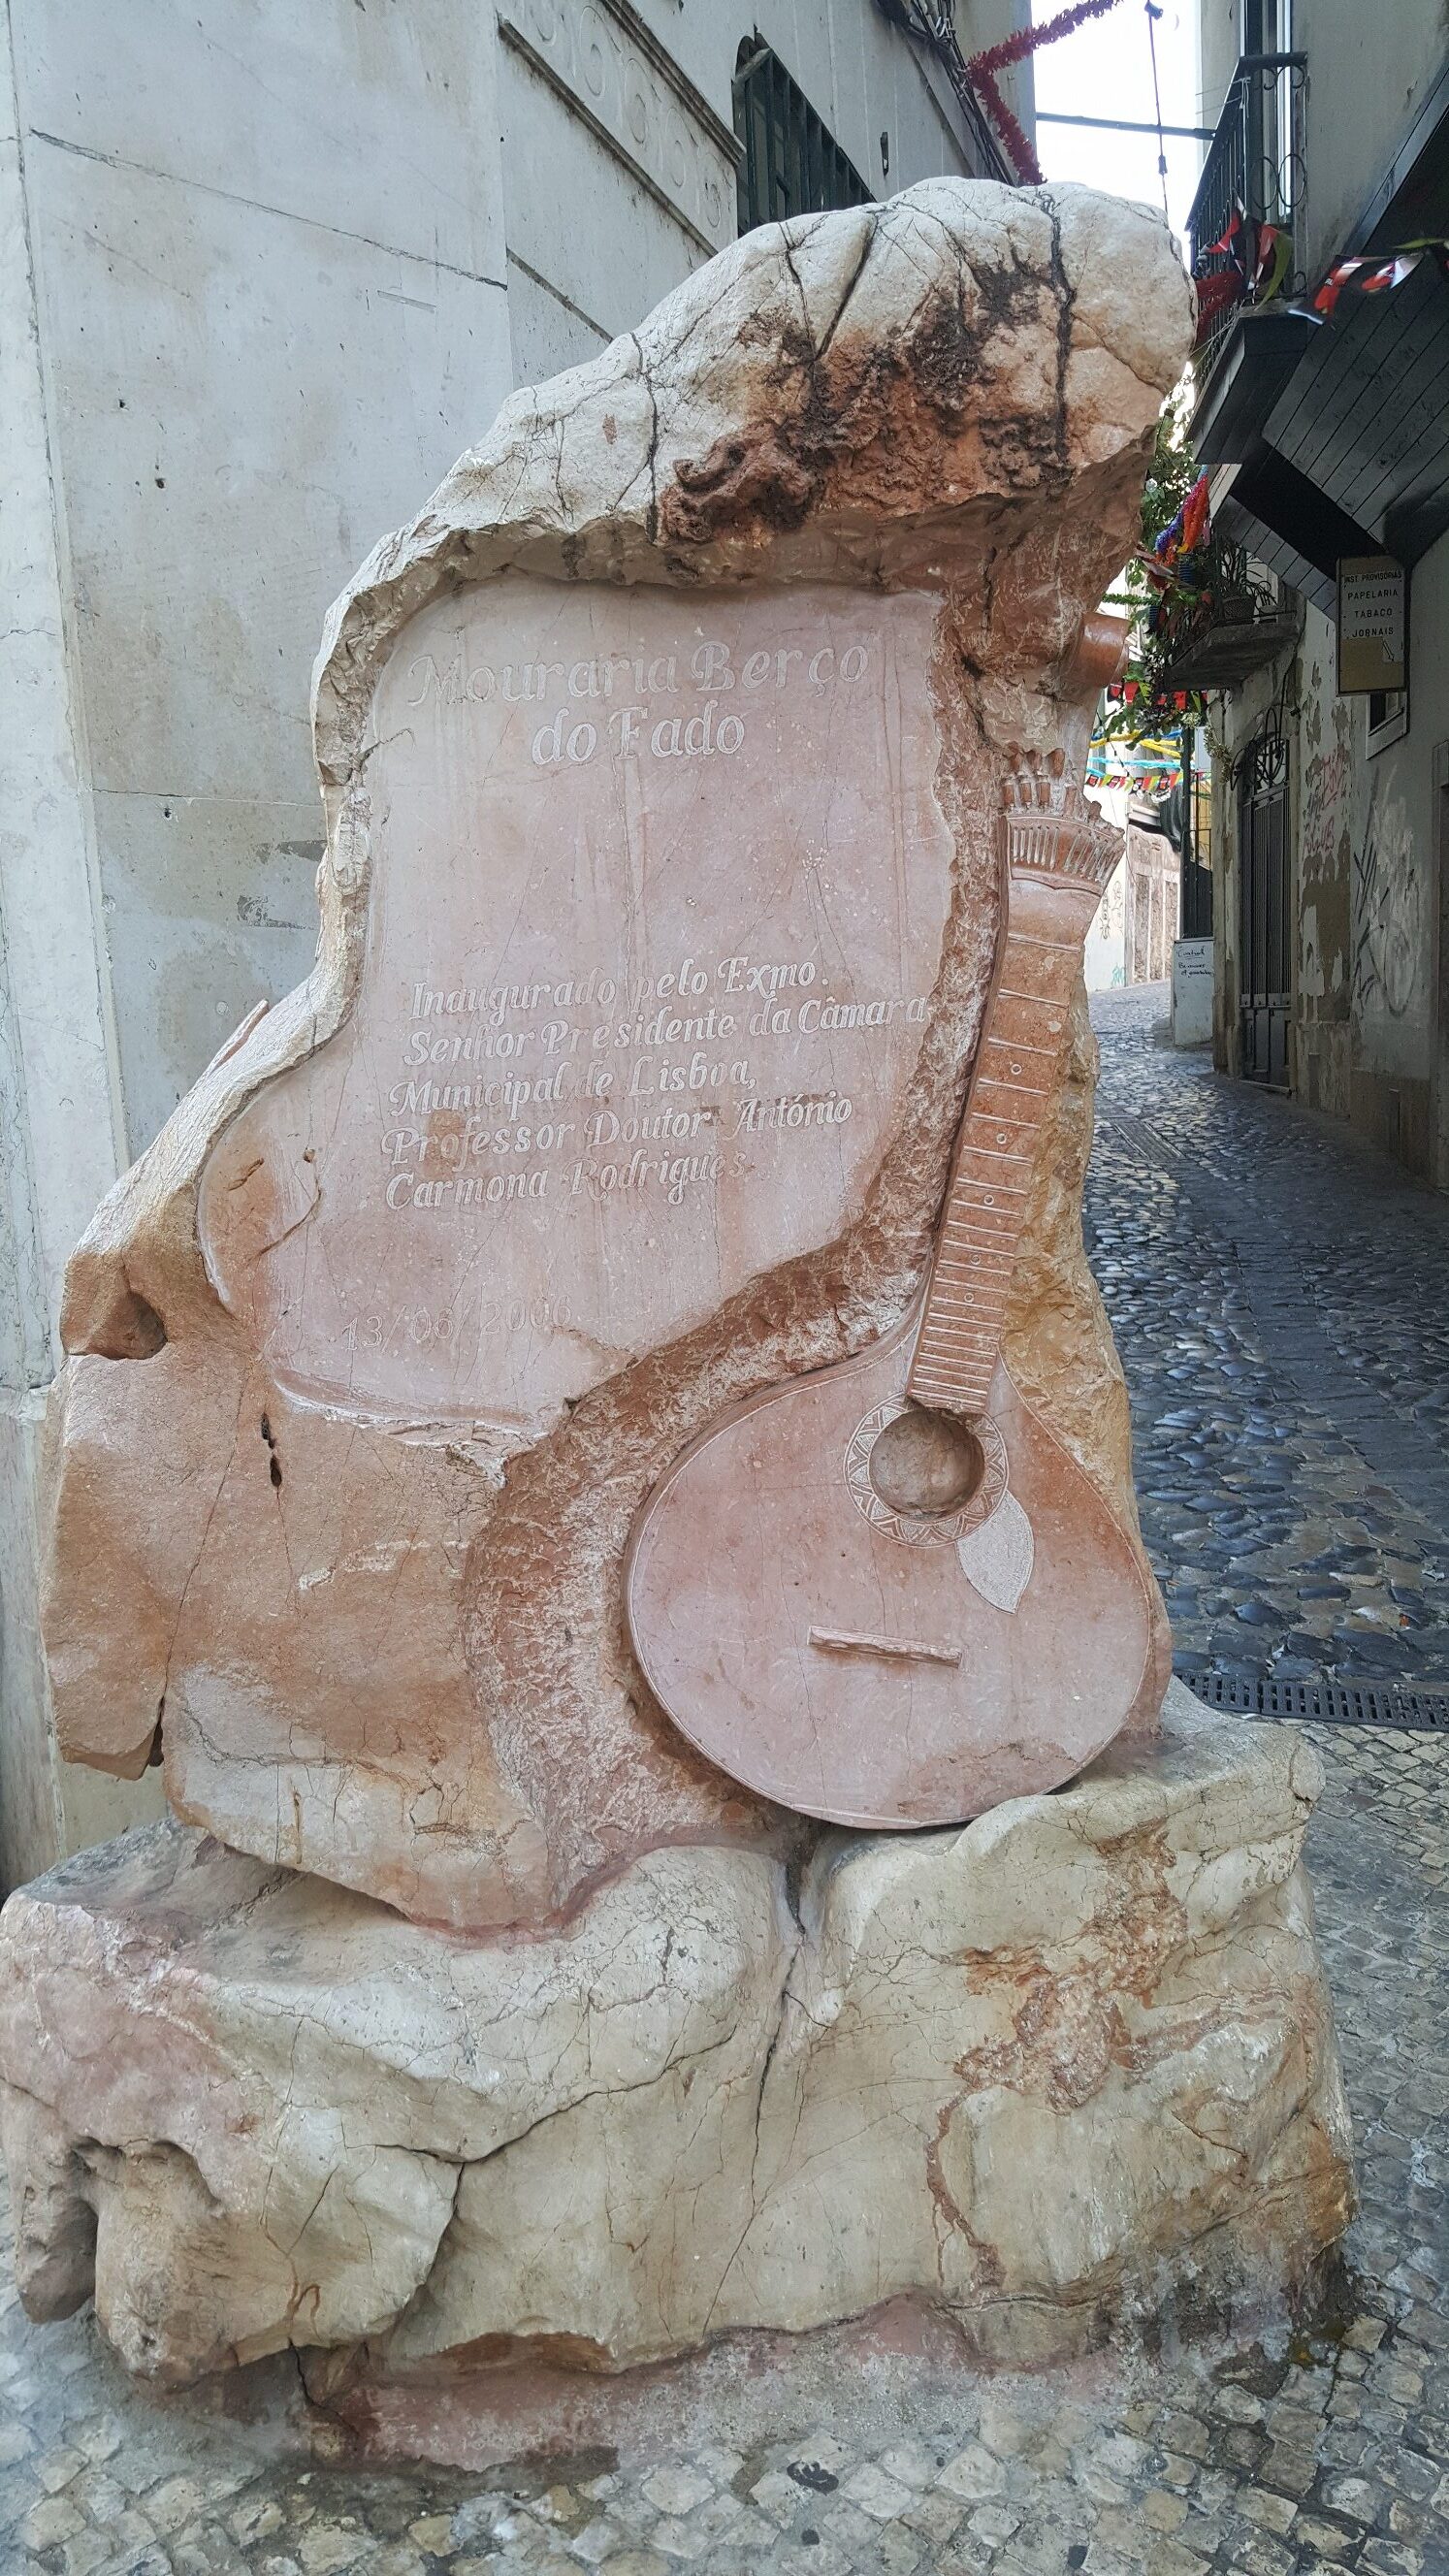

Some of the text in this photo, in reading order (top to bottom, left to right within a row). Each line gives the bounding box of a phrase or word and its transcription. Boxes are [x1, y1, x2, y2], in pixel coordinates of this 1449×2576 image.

[1347, 589, 1399, 600] PAPELARIA
[1354, 608, 1393, 619] TABACO
[1352, 627, 1394, 637] JORNAIS
[407, 640, 870, 708] Mouraria Berço
[531, 699, 746, 766] do Fado
[408, 967, 616, 1027] Inaugurado
[630, 957, 709, 1014] pelo
[403, 996, 928, 1067] Senhor Presidente da Câmara
[389, 1051, 757, 1123] Municipal de Lisboa,
[381, 1089, 853, 1173] Professor Doutor António
[386, 1148, 748, 1210] Carmona Rodrigues
